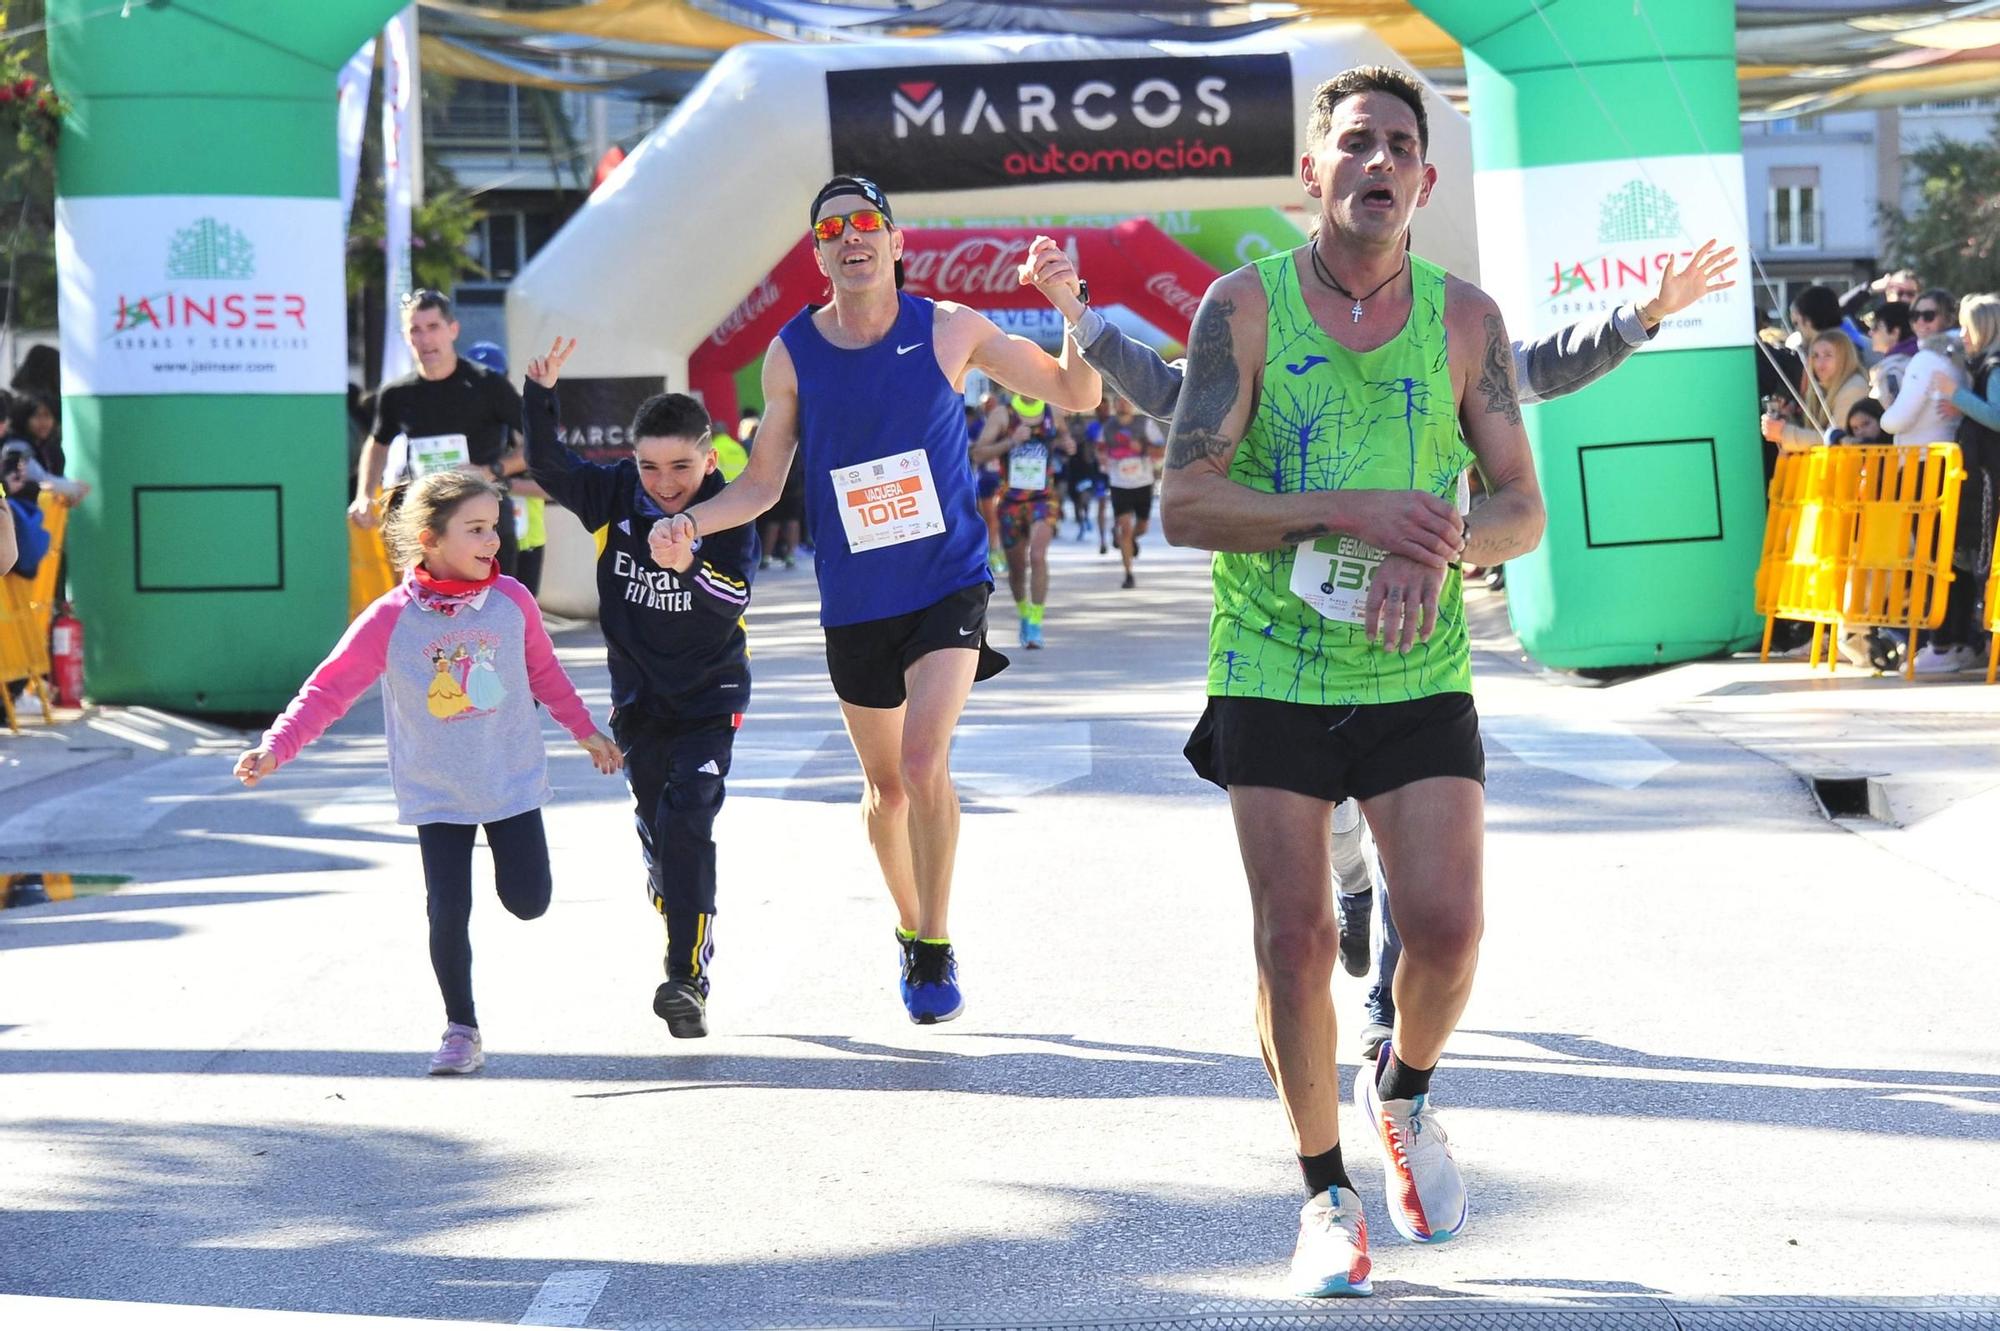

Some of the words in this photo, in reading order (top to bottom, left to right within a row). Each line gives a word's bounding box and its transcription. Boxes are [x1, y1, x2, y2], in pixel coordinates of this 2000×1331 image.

[891, 77, 1232, 138] MARCOS
[1003, 139, 1233, 176] automoción
[115, 292, 305, 331] JAINSER
[864, 482, 904, 502] VAQUERA
[858, 496, 919, 528] 1012
[624, 581, 648, 604] FLY
[646, 588, 692, 612] BETTER
